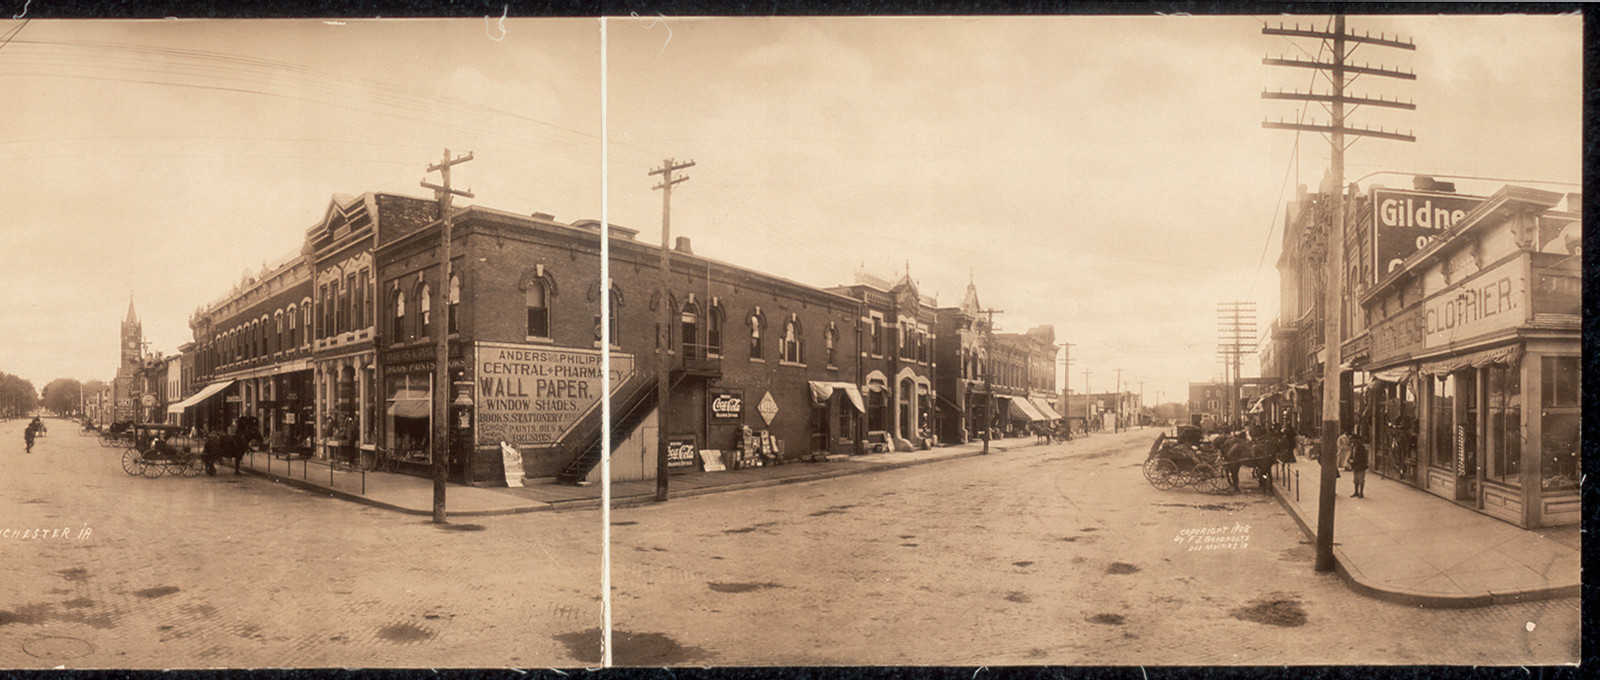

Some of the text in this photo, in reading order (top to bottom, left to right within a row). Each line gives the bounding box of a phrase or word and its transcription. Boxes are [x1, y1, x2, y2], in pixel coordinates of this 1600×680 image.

[498, 350, 547, 362] ANDERS
[482, 361, 548, 377] CENTRAL
[479, 377, 593, 399] WALL PAPER.
[486, 399, 531, 411] WINDOW
[540, 425, 556, 433] OILS
